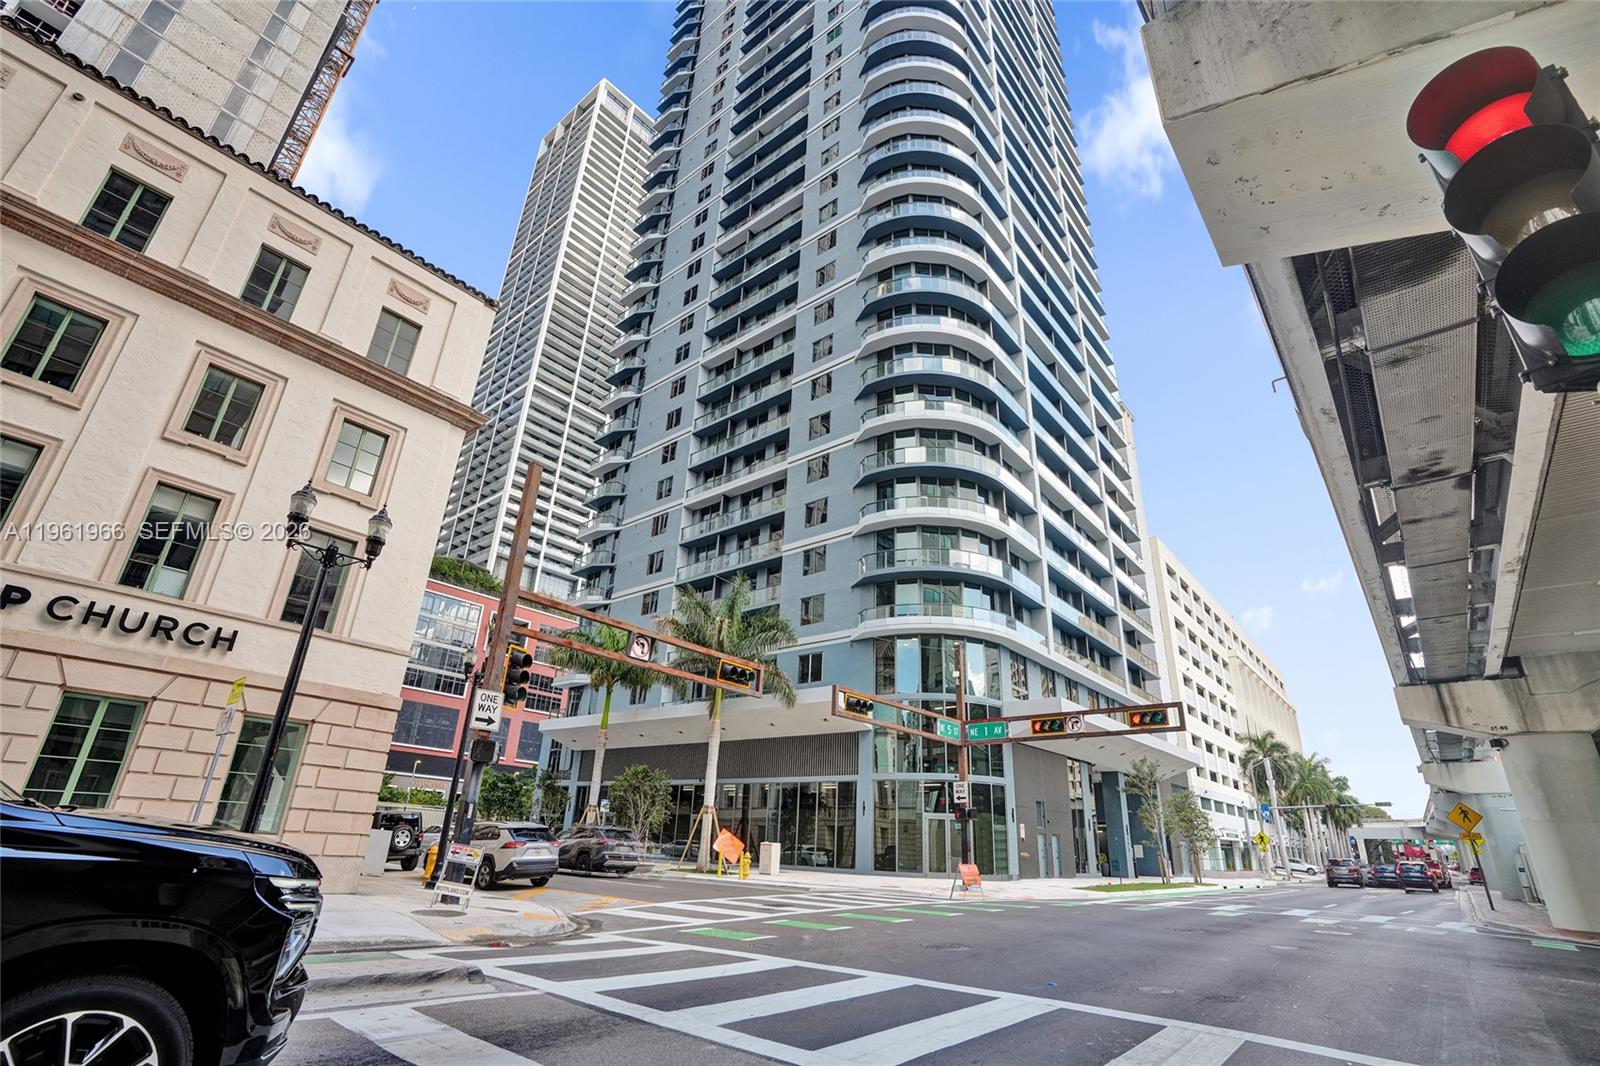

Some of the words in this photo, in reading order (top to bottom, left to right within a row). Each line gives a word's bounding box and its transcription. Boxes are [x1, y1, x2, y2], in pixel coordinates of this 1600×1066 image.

[0, 584, 32, 610] P
[46, 595, 239, 652] CHURCH
[480, 693, 499, 704] ONE
[478, 703, 498, 713] WAY
[970, 728, 978, 736] NE
[984, 727, 988, 736] 1
